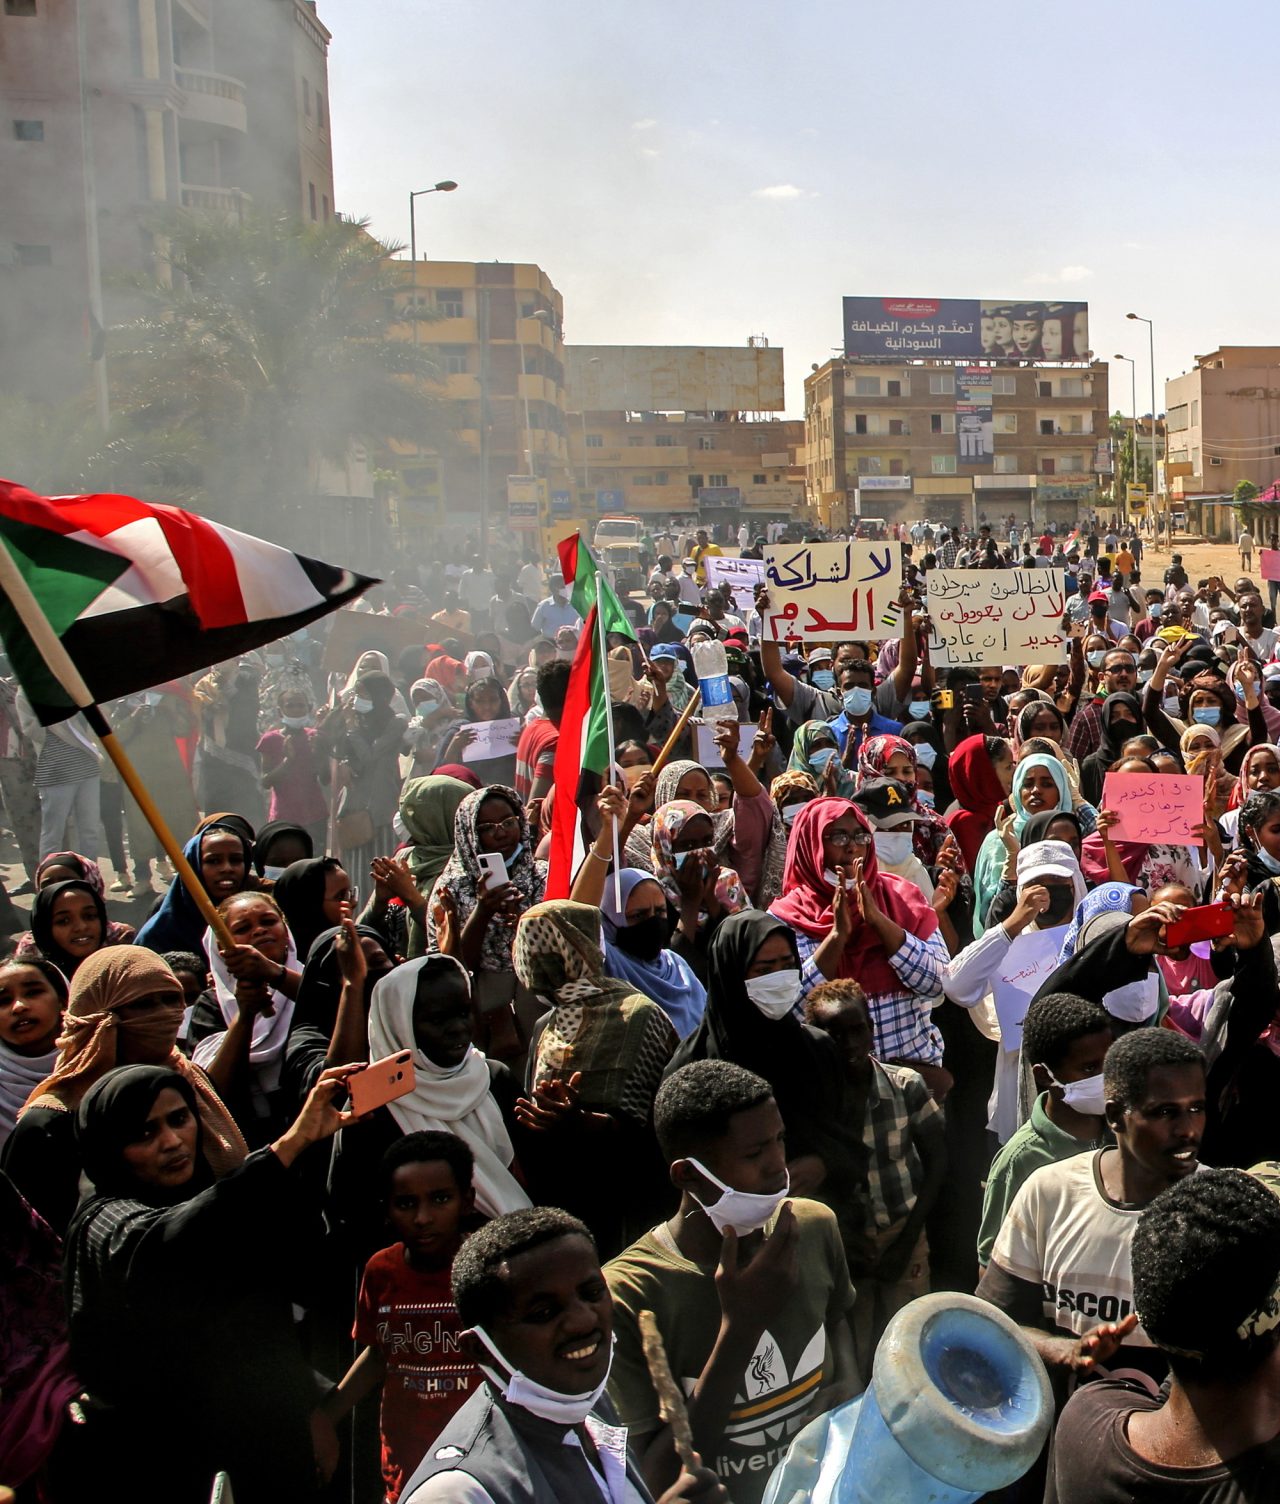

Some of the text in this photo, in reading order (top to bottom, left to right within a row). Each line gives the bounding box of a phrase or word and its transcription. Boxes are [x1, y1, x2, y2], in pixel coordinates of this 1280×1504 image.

[851, 320, 898, 334] الضيافة
[902, 322, 934, 335] بكرم
[885, 337, 941, 350] السودانية
[857, 547, 892, 582] لا
[930, 569, 1059, 600] الظالمون سيرحلون
[769, 587, 875, 641] الدم
[952, 601, 1004, 625] يعودوا
[1012, 594, 1037, 623] لن
[1042, 592, 1065, 618] لا
[930, 624, 974, 650] عادوا
[1021, 633, 1064, 647] جديد
[946, 647, 985, 664] عدنا
[1139, 801, 1185, 814] برهان
[403, 1376, 469, 1392] FASHION
